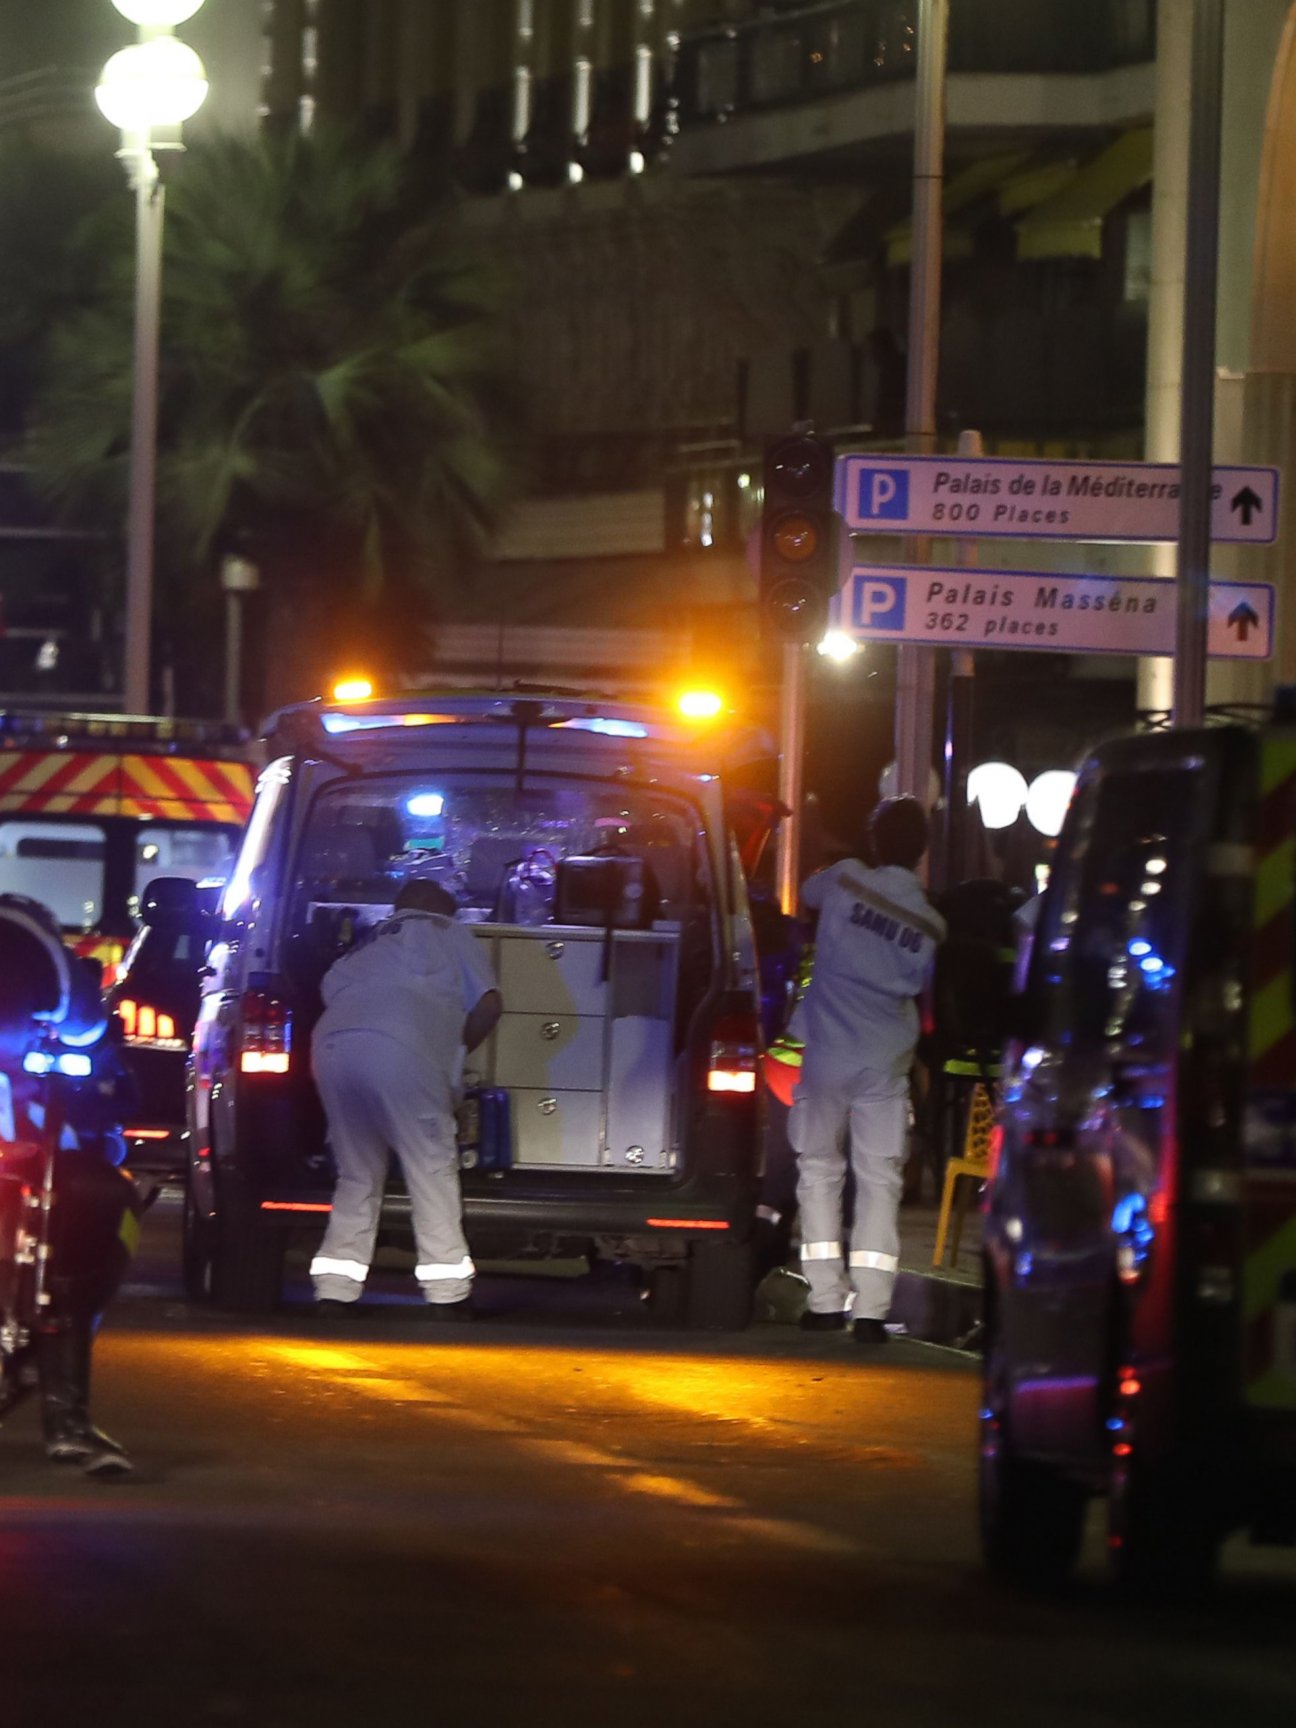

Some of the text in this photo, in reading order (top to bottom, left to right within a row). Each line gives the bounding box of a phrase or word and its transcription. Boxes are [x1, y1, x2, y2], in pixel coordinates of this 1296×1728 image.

[933, 472, 1001, 495] Palais
[1008, 474, 1036, 496] de
[1041, 475, 1062, 496] la
[1066, 475, 1222, 500] Méditerrae
[932, 503, 1070, 524] 800 Places
[927, 582, 1015, 608] Palais
[1034, 586, 1157, 614] Masséna
[925, 611, 1059, 638] 362 places
[850, 900, 900, 941] SAMU
